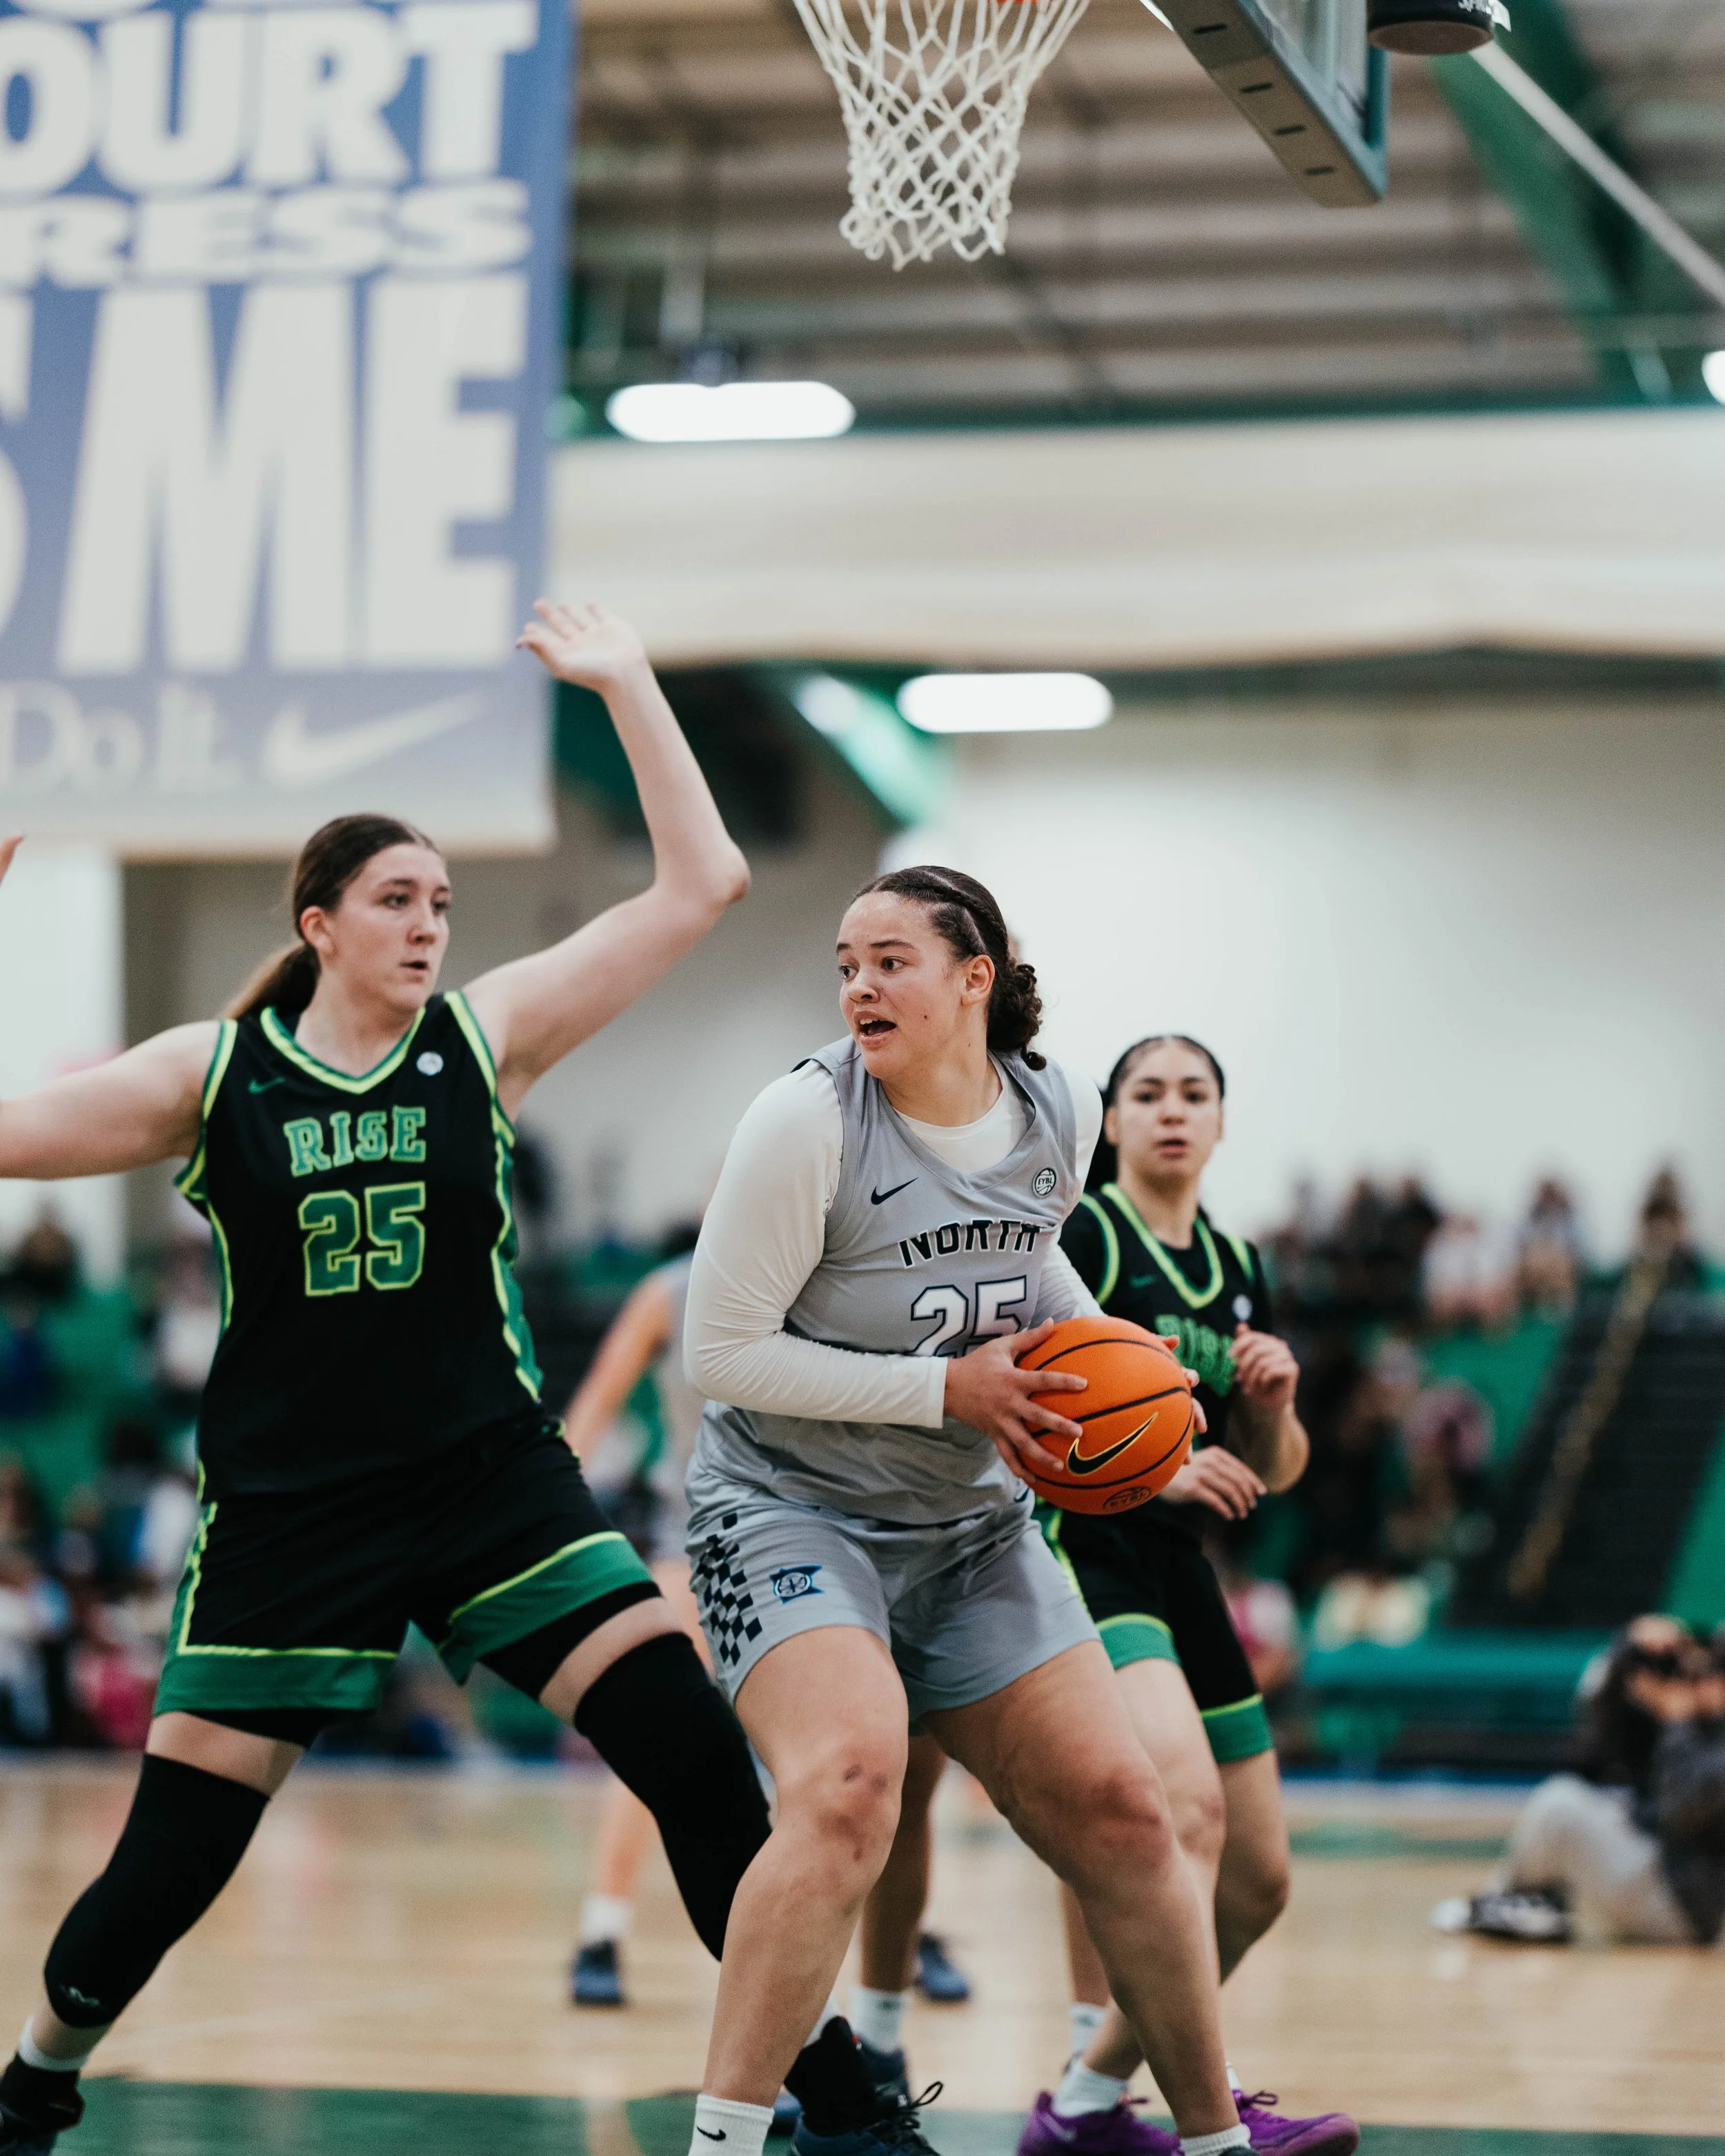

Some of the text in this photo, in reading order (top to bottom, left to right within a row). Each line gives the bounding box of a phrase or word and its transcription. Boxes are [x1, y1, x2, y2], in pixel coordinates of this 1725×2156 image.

[58, 275, 529, 673] ME
[283, 1105, 426, 1177] RISE
[297, 1181, 426, 1297] 25
[898, 1218, 1041, 1269] NORTH
[910, 1275, 1027, 1358] 25
